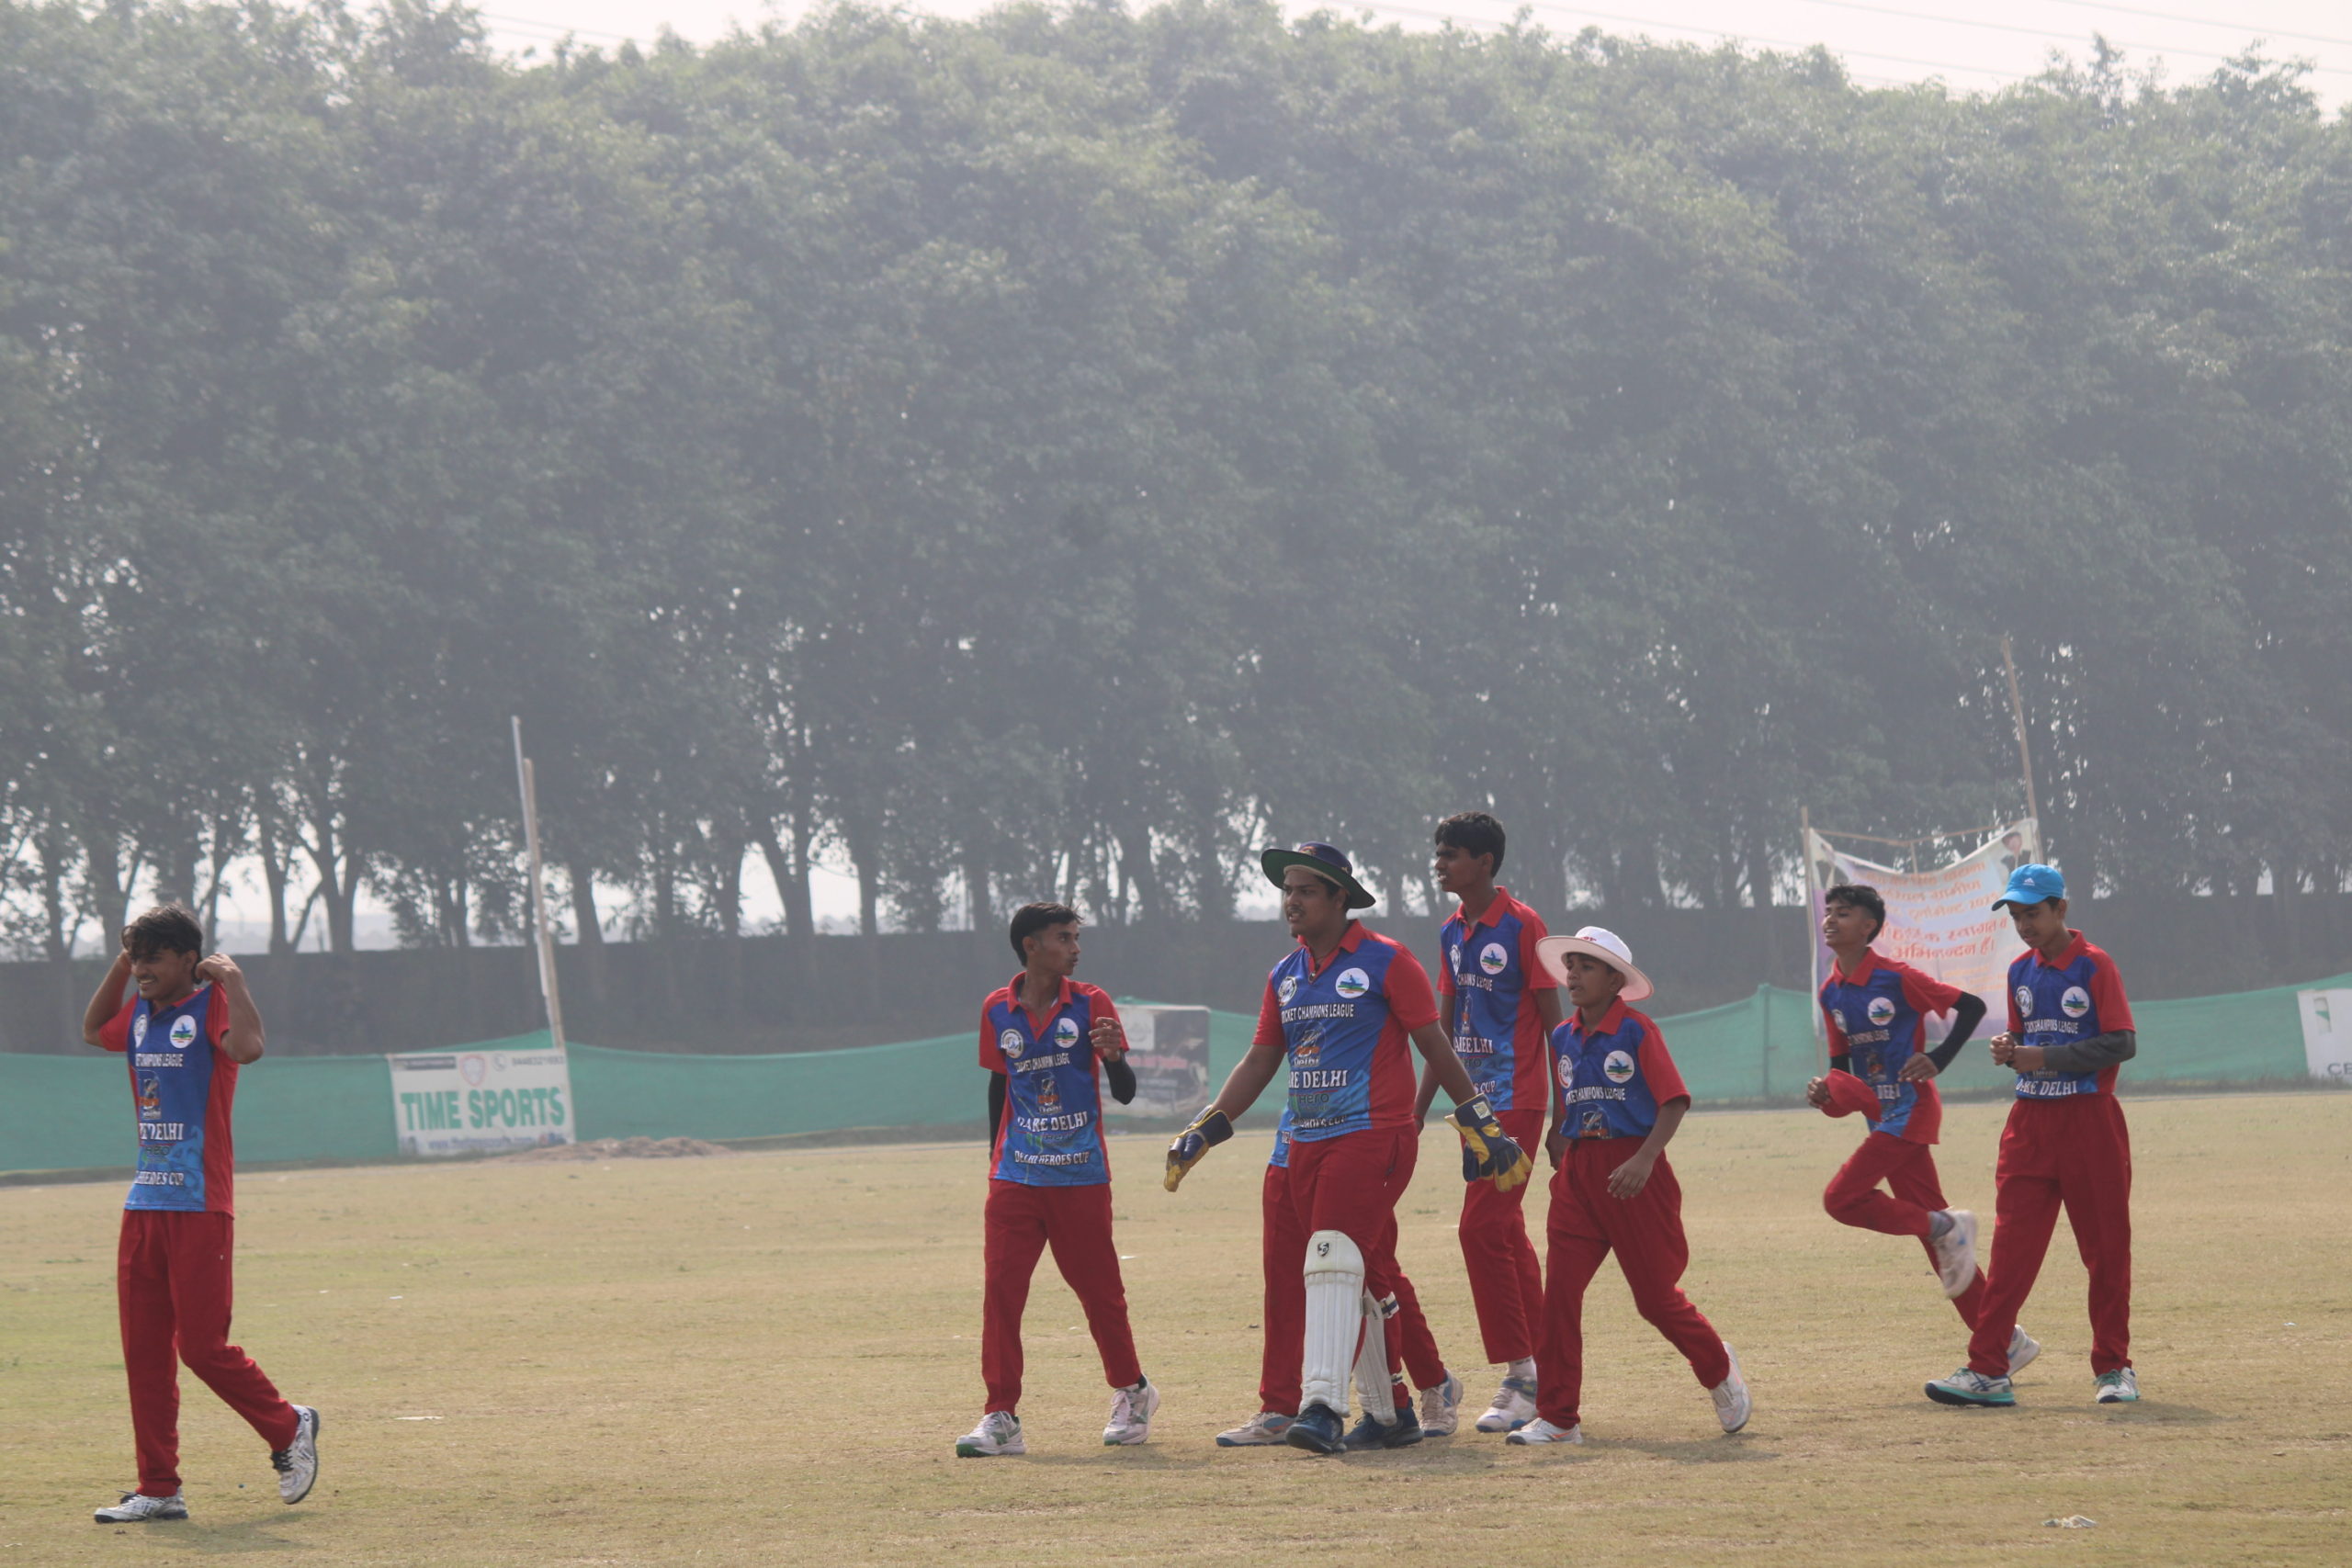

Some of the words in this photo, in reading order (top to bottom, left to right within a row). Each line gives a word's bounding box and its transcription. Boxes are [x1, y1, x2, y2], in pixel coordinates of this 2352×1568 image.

[1329, 1004, 1354, 1017] LEAGUE
[1303, 1070, 1348, 1089] DELHI
[2040, 1080, 2078, 1096] DELHI
[401, 1090, 463, 1131] TIME
[468, 1086, 566, 1129] SPORTS
[1051, 1111, 1088, 1131] DELHI
